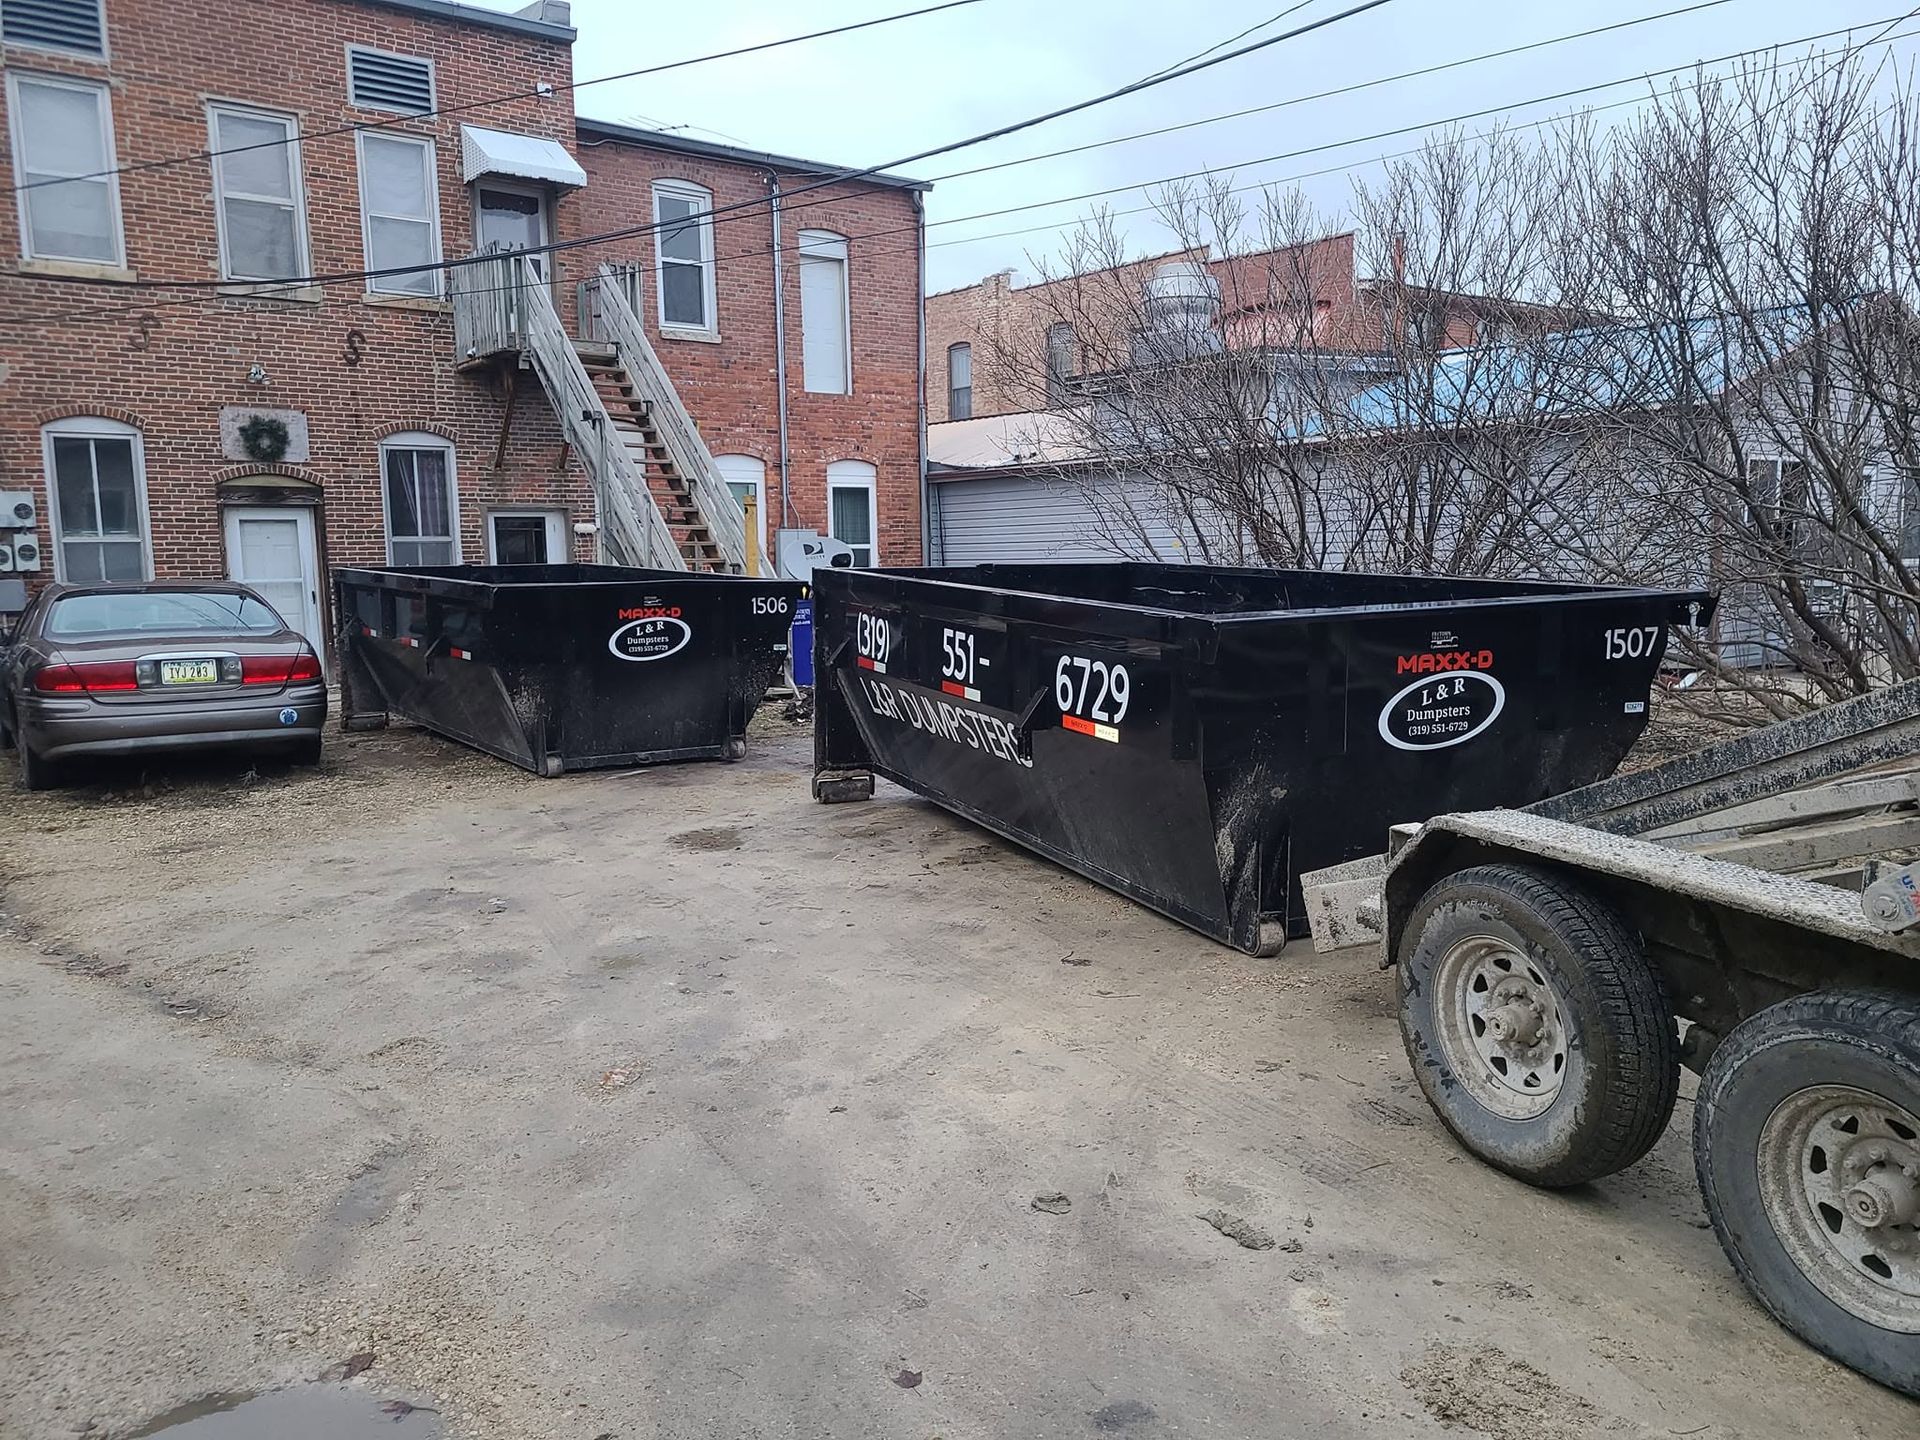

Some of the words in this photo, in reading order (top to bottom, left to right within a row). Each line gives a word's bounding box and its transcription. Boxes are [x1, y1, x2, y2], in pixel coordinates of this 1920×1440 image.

[751, 596, 788, 615] 1506
[636, 626, 644, 636] L
[645, 623, 654, 634] &
[656, 621, 665, 631] R
[627, 636, 669, 645] Dumpsters
[1604, 626, 1659, 660] 1507
[169, 666, 187, 679] IYJ
[857, 611, 890, 663] (319)
[1056, 655, 1130, 724] 6729
[1421, 689, 1433, 706] L
[1436, 684, 1449, 700] &
[1453, 678, 1465, 695] R
[1406, 705, 1471, 722] Dumpsters
[1408, 724, 1430, 737] (319)
[1431, 720, 1469, 734] 551-6729
